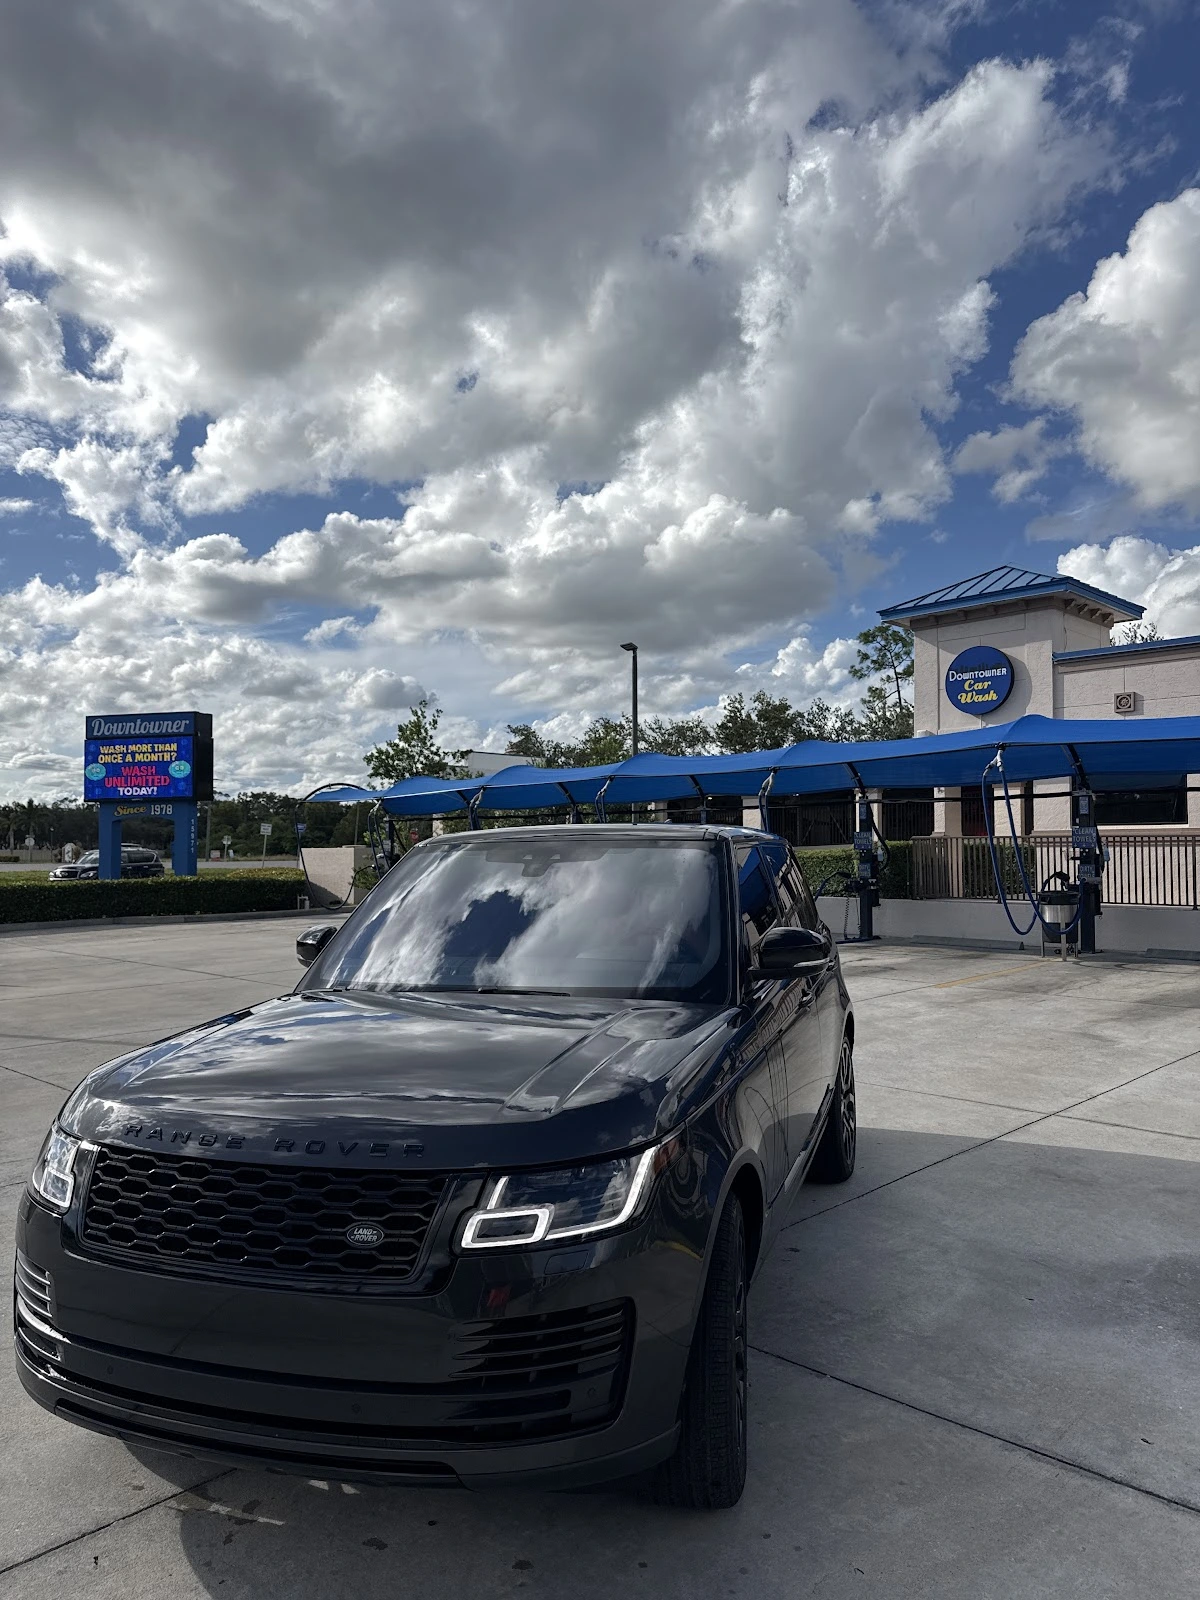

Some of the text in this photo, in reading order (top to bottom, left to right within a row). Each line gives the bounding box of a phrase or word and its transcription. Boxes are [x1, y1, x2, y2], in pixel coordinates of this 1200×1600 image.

[964, 680, 991, 690] Car
[958, 690, 998, 703] Wash
[91, 719, 189, 736] Downtowner
[100, 743, 177, 753] WASH MORE THAN
[98, 752, 177, 763] ONCE A MONTH?
[121, 766, 156, 776] WASH
[104, 776, 170, 787] UNLIMITED
[118, 787, 157, 795] TODAY!
[114, 804, 173, 816] Since 1978
[124, 1124, 424, 1158] RANGE ROVER
